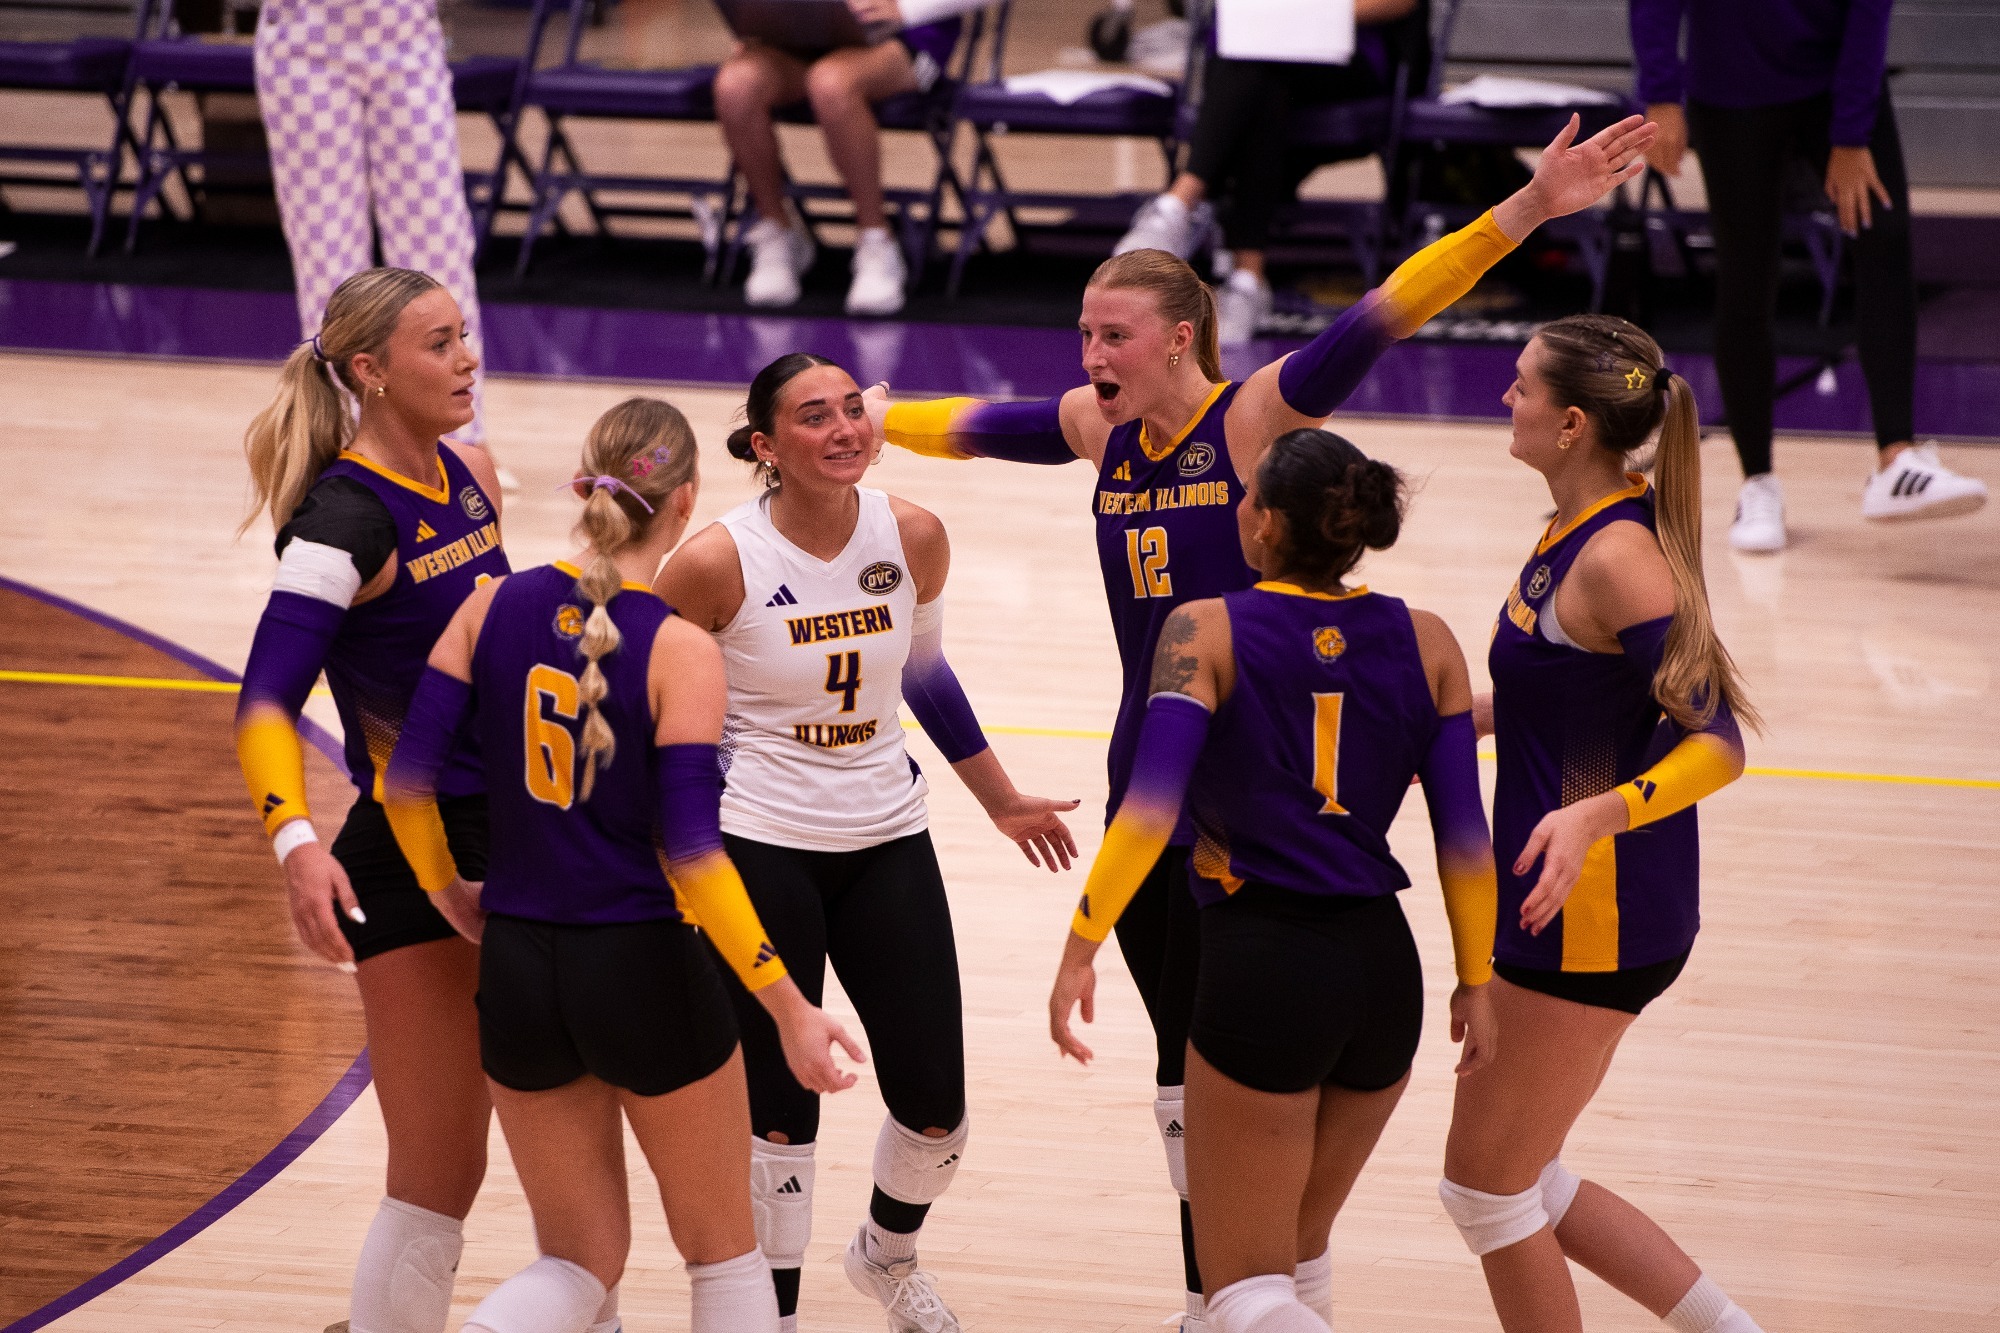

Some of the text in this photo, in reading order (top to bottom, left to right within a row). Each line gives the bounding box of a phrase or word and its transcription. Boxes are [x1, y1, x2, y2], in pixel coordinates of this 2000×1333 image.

[1155, 481, 1229, 511] ILLINOIS
[405, 537, 474, 584] WESTERN
[868, 570, 892, 587] OVC
[1124, 526, 1173, 599] 12
[784, 603, 894, 646] WESTERN
[824, 649, 863, 714] 4
[523, 663, 580, 811] 6
[793, 718, 879, 749] ILLINOIS
[1311, 692, 1351, 816] 1
